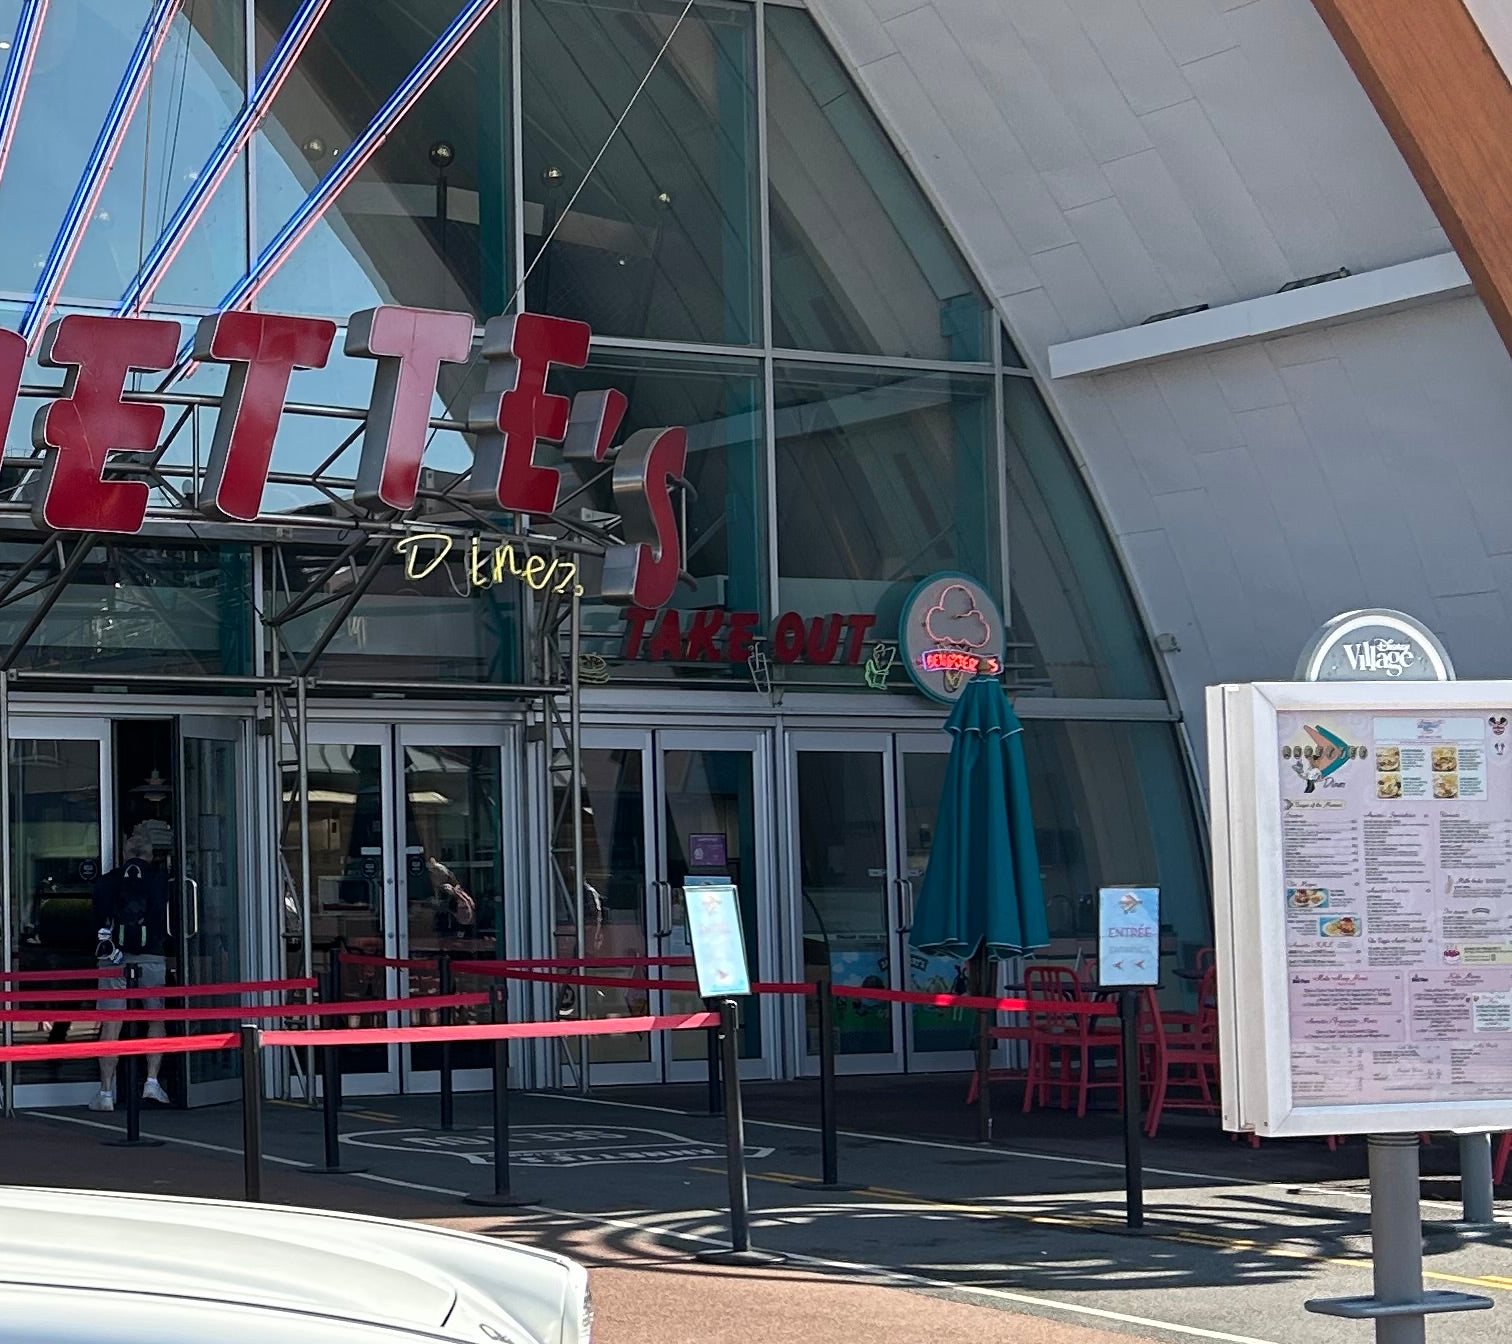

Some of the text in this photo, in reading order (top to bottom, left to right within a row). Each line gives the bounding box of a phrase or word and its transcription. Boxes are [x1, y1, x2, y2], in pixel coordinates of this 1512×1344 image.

[621, 607, 877, 665] TAKE OUT
[1343, 640, 1414, 677] Village
[1107, 922, 1152, 938] ENTRÉE
